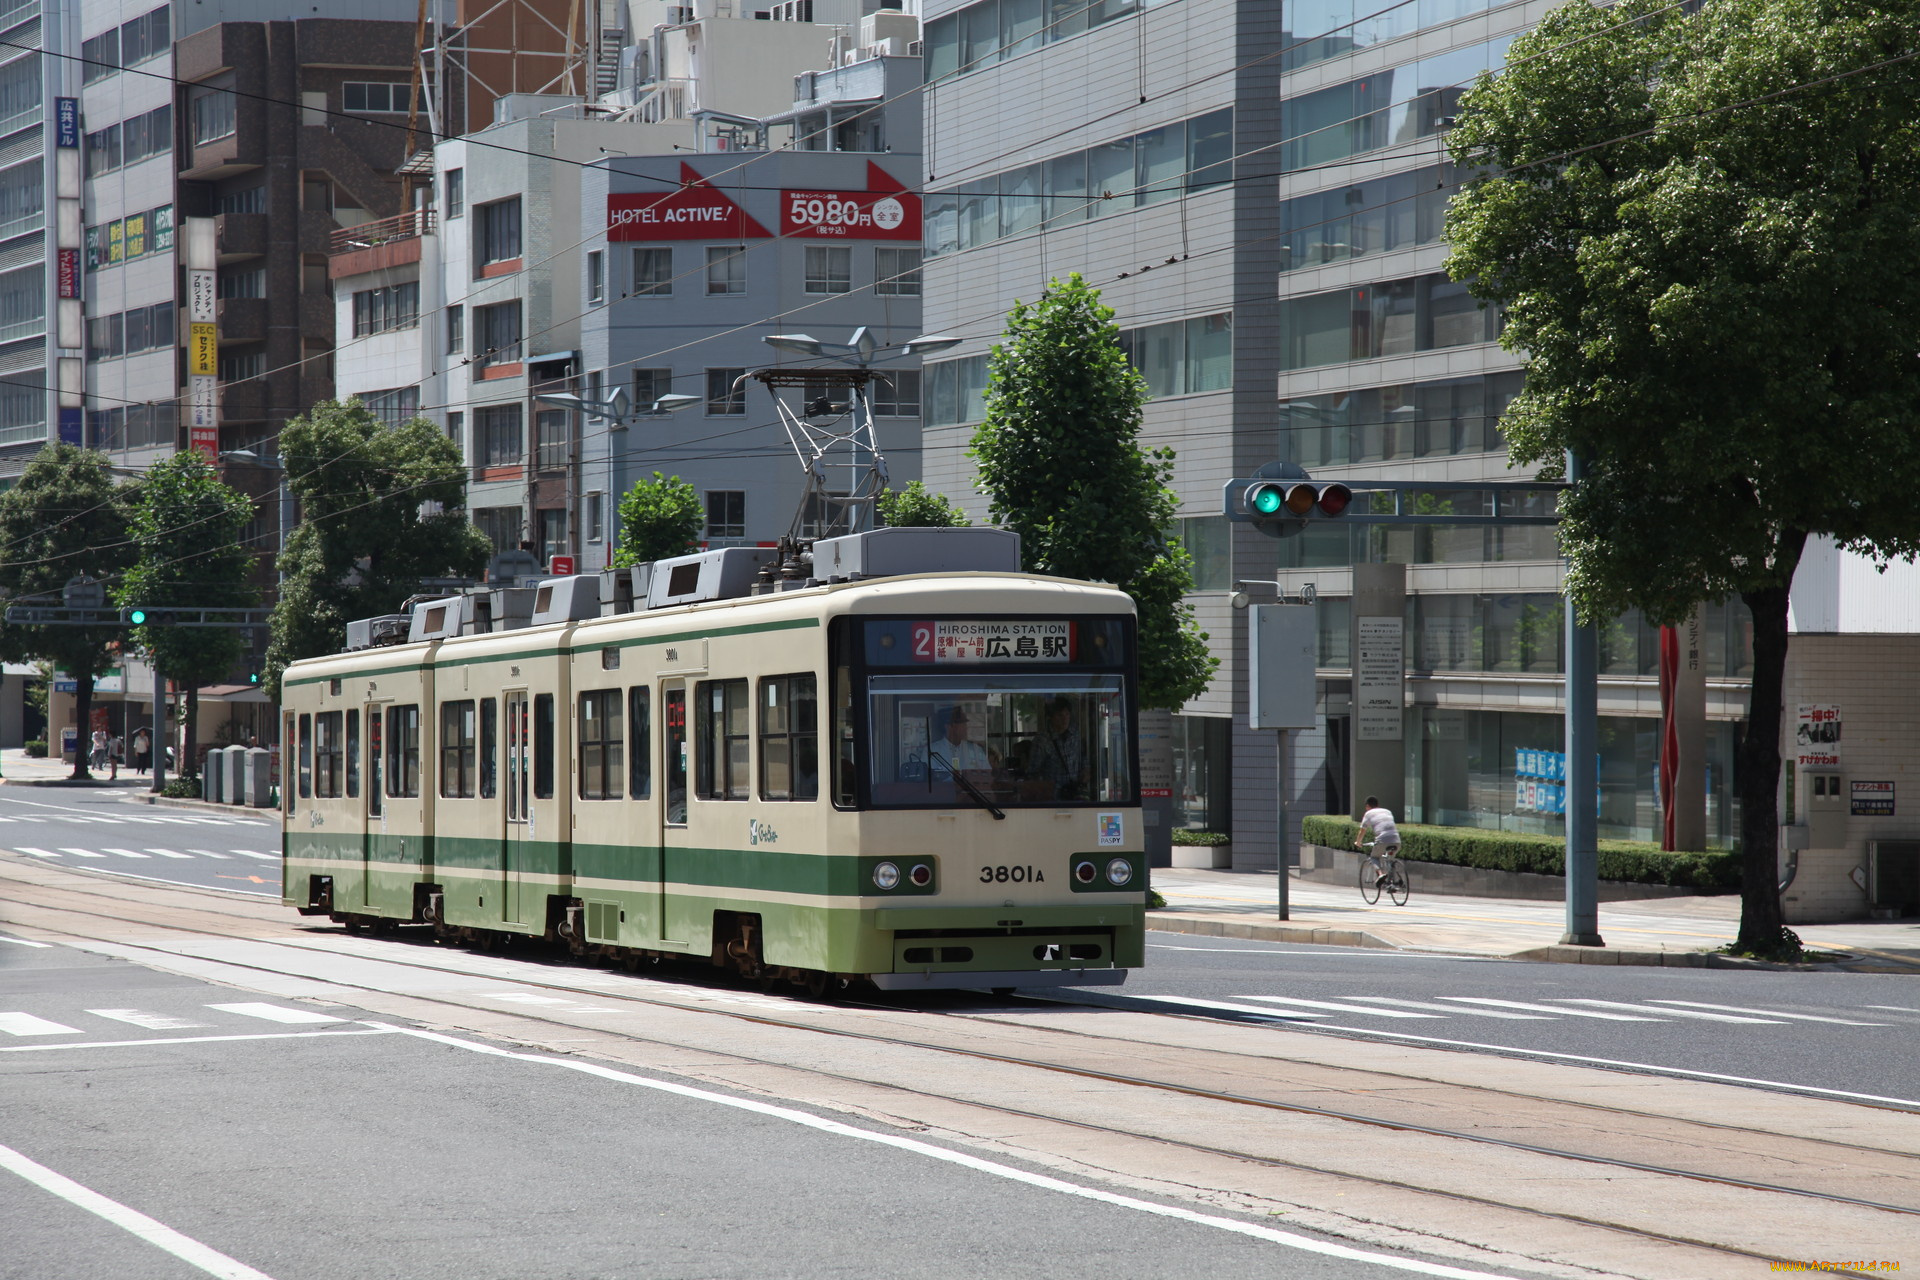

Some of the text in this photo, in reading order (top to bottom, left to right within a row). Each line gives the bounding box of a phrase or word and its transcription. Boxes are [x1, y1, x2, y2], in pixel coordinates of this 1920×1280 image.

[60, 100, 73, 146] 広共ビル
[610, 206, 733, 223] HOTEL ACTIVE!
[790, 199, 871, 227] 5980円
[192, 325, 214, 334] SEC
[938, 625, 1066, 635] HIROSHIMA STATION
[914, 628, 930, 656] 2
[937, 636, 985, 647] 原爆ドーム前
[985, 635, 1068, 658] 広島駅
[937, 647, 985, 658] 紙屋町
[1799, 709, 1840, 722] 一掃中!
